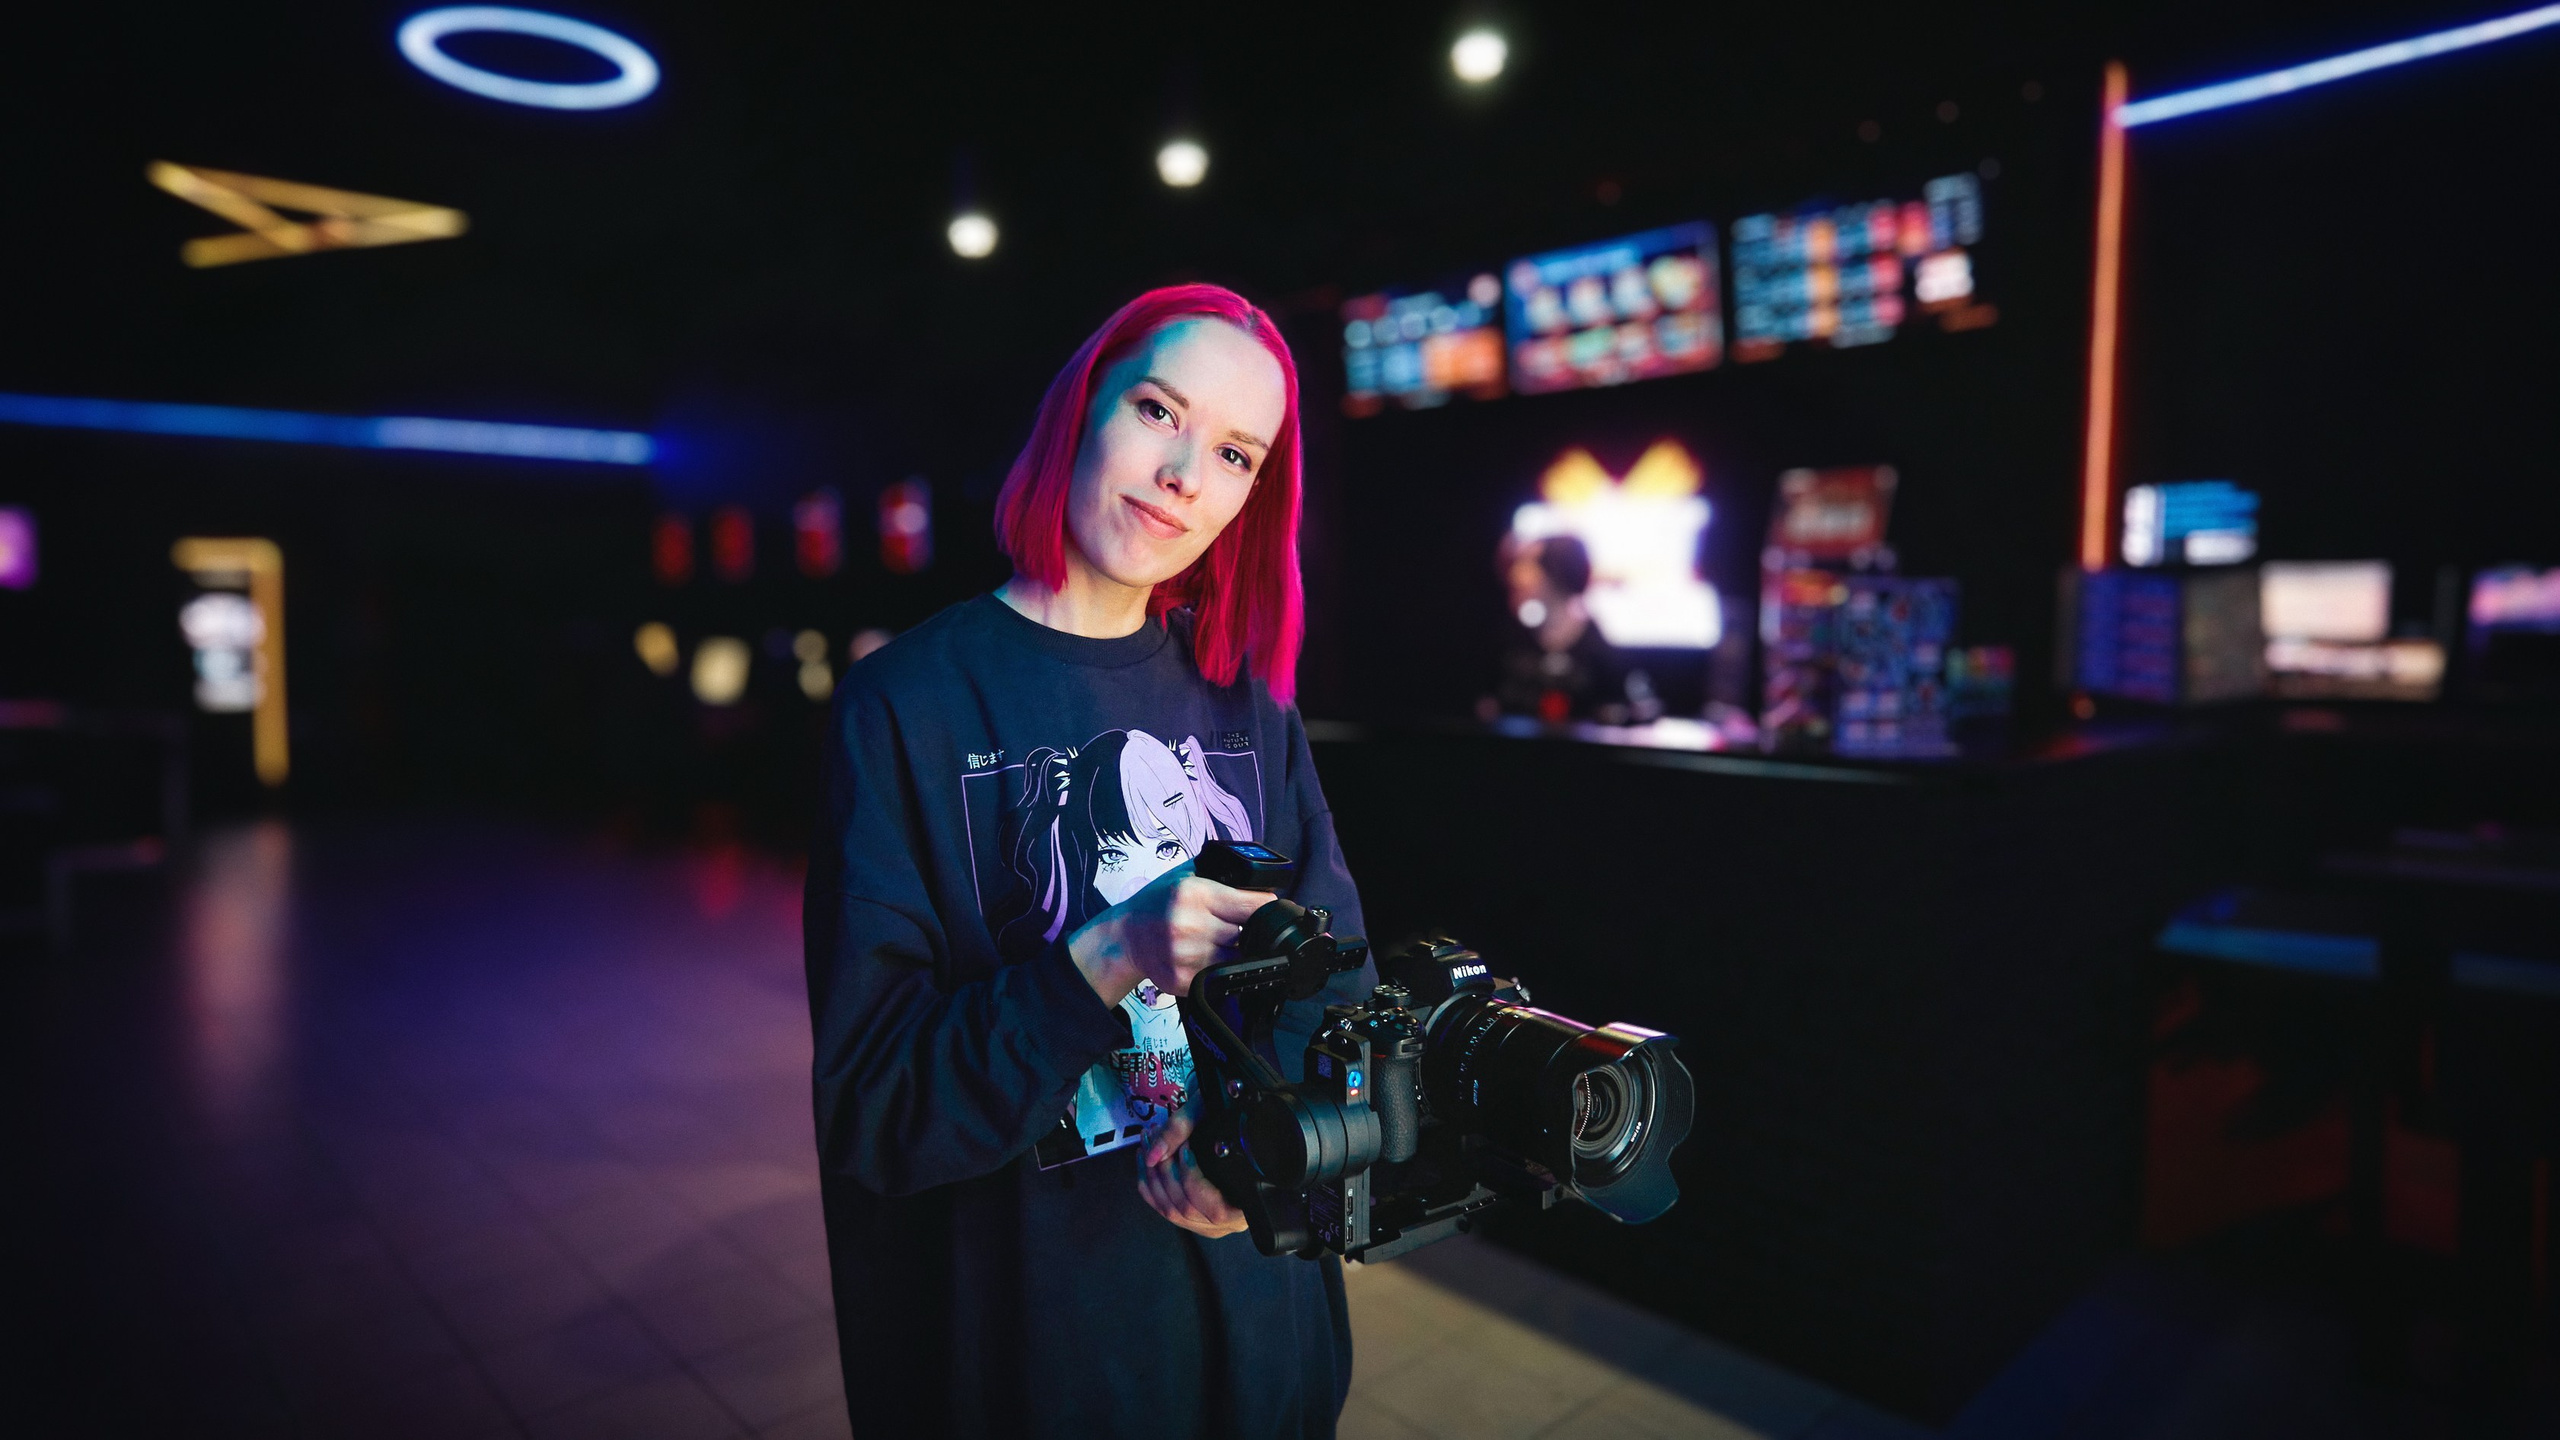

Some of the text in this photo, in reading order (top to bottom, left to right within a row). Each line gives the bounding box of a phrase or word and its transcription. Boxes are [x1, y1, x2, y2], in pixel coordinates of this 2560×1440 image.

[967, 748, 1005, 769] 信じます
[1452, 964, 1487, 980] Nikon
